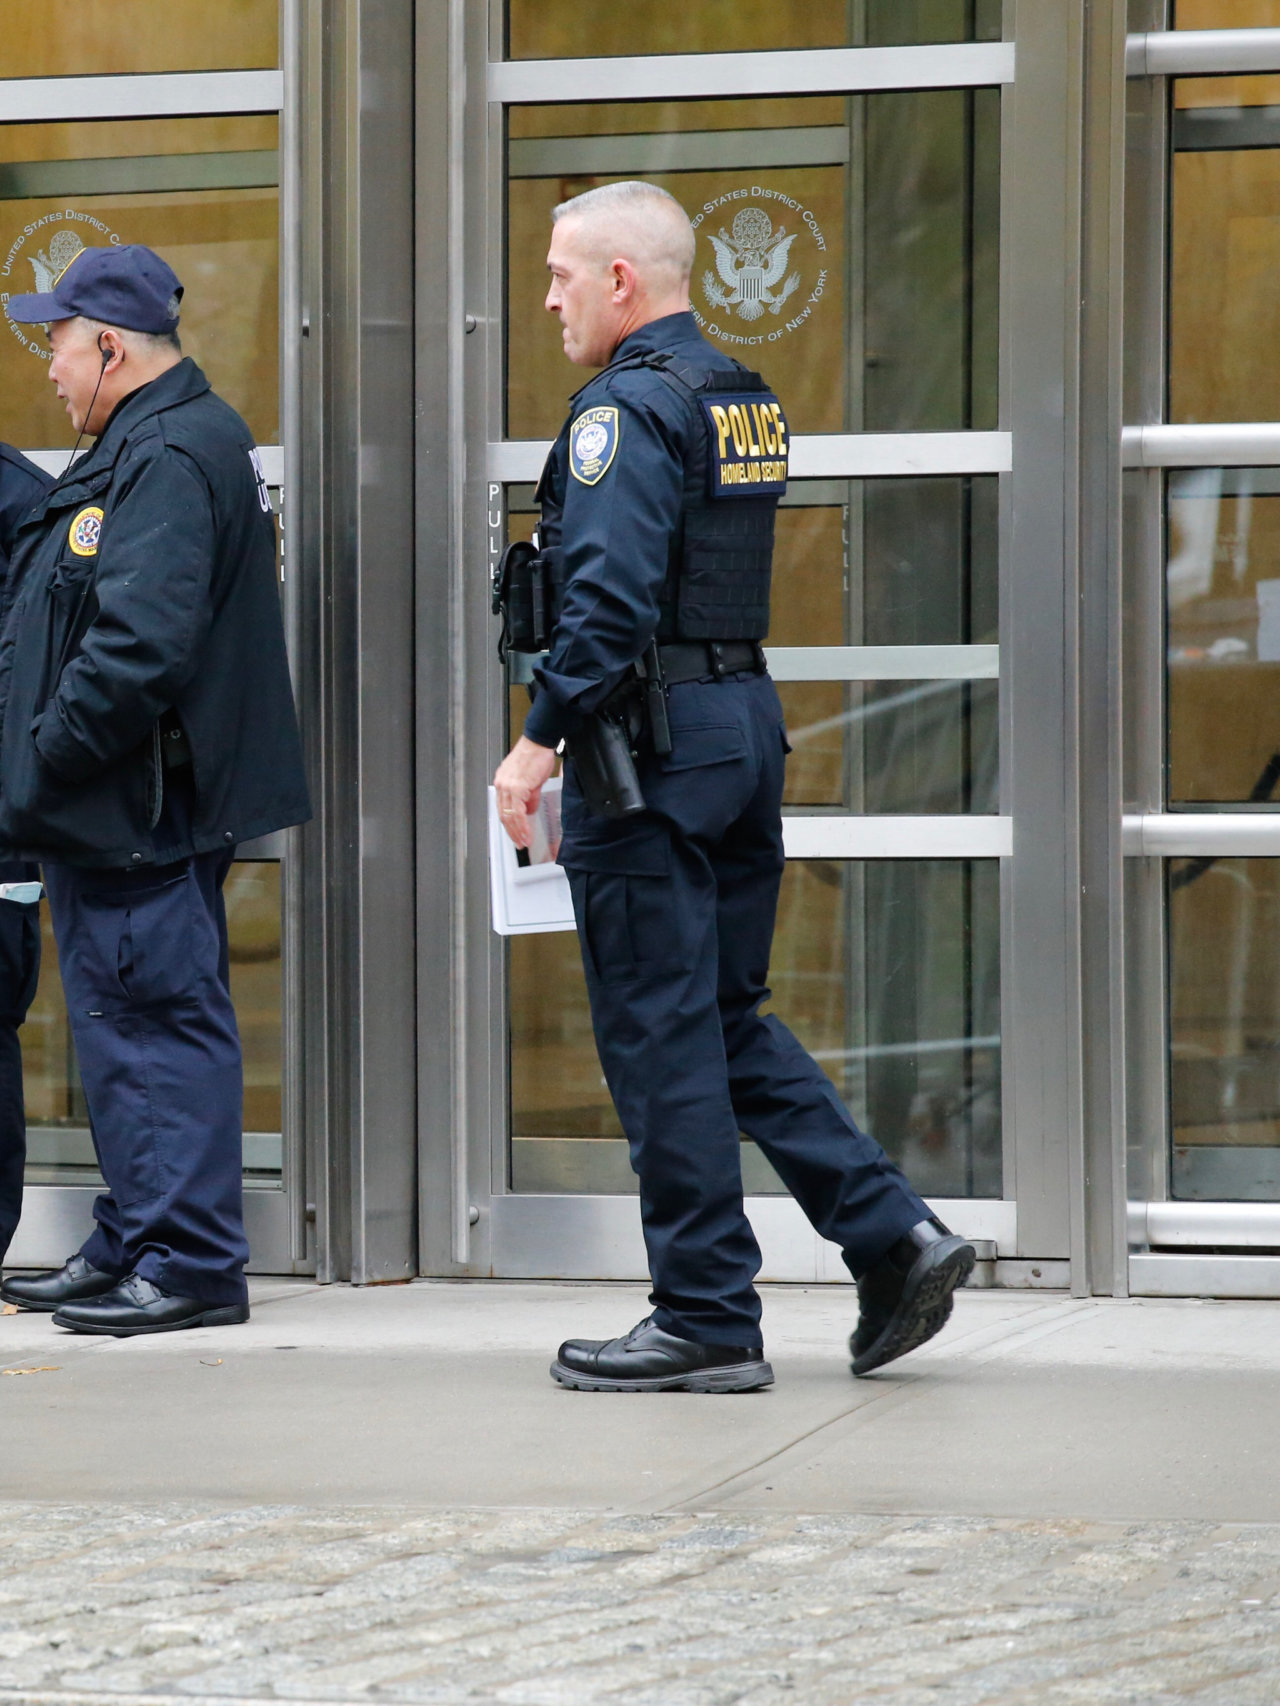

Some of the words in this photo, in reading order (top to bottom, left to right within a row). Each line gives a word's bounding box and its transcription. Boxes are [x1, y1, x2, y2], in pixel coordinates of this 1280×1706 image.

[1, 236, 25, 276] UNITED
[24, 212, 63, 236] STATES
[65, 209, 111, 235] DISTRICT
[704, 188, 748, 214] STATES
[751, 186, 804, 213] DISTRICT
[802, 210, 827, 252] COURT
[707, 323, 764, 345] DISTRICT
[767, 328, 784, 342] OF
[785, 306, 812, 333] NEW
[808, 269, 828, 304] YORK
[574, 411, 613, 434] POLICE
[710, 403, 787, 459] POLICE
[488, 484, 501, 580] PULL
